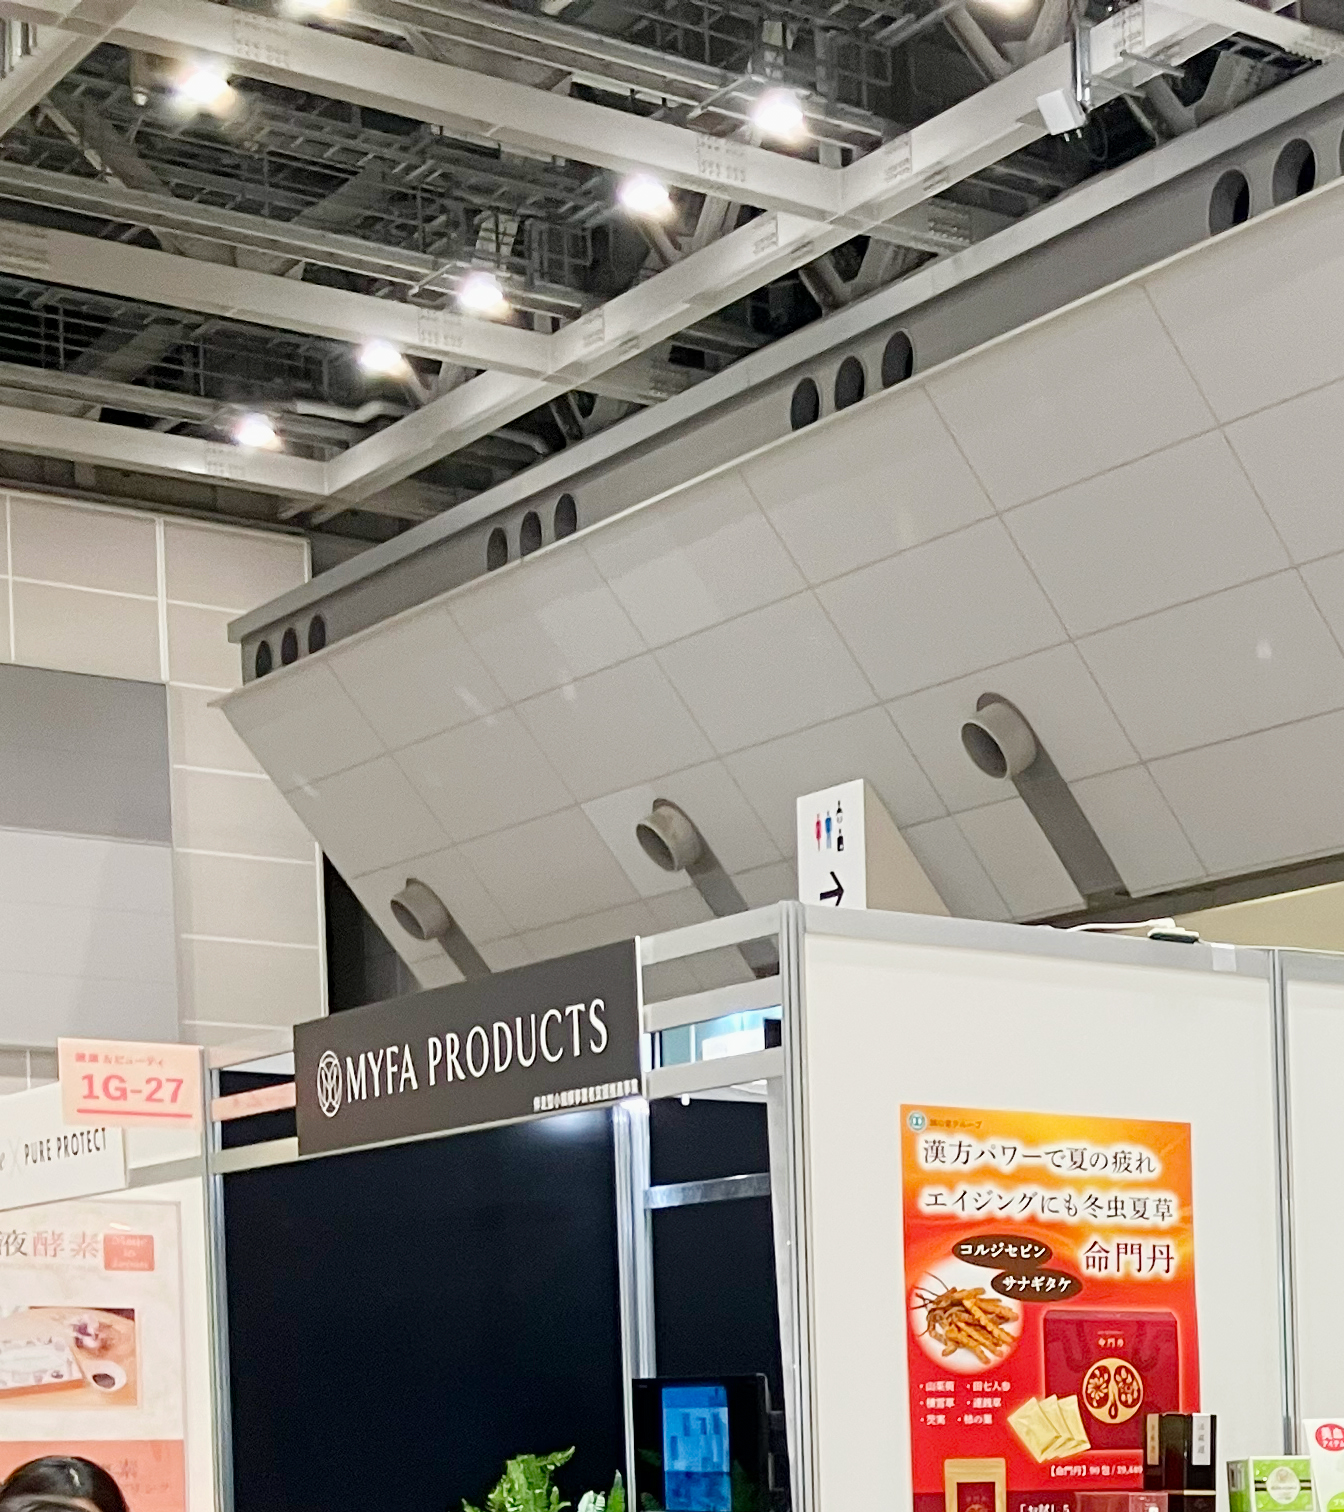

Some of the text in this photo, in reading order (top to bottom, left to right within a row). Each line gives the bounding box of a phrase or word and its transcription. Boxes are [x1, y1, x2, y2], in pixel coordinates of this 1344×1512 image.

[346, 998, 609, 1102] MYFA PRODUCTS
[81, 1073, 184, 1103] 1G-27
[24, 1138, 52, 1165] PURE
[56, 1127, 107, 1160] PROTECT
[923, 1138, 1157, 1174] 漢方パワーで夏の疲れ
[924, 1188, 1174, 1222] エイジングにも冬虫夏草
[1083, 1240, 1175, 1274] 命門丹
[1002, 1276, 1073, 1293] サナギタケ
